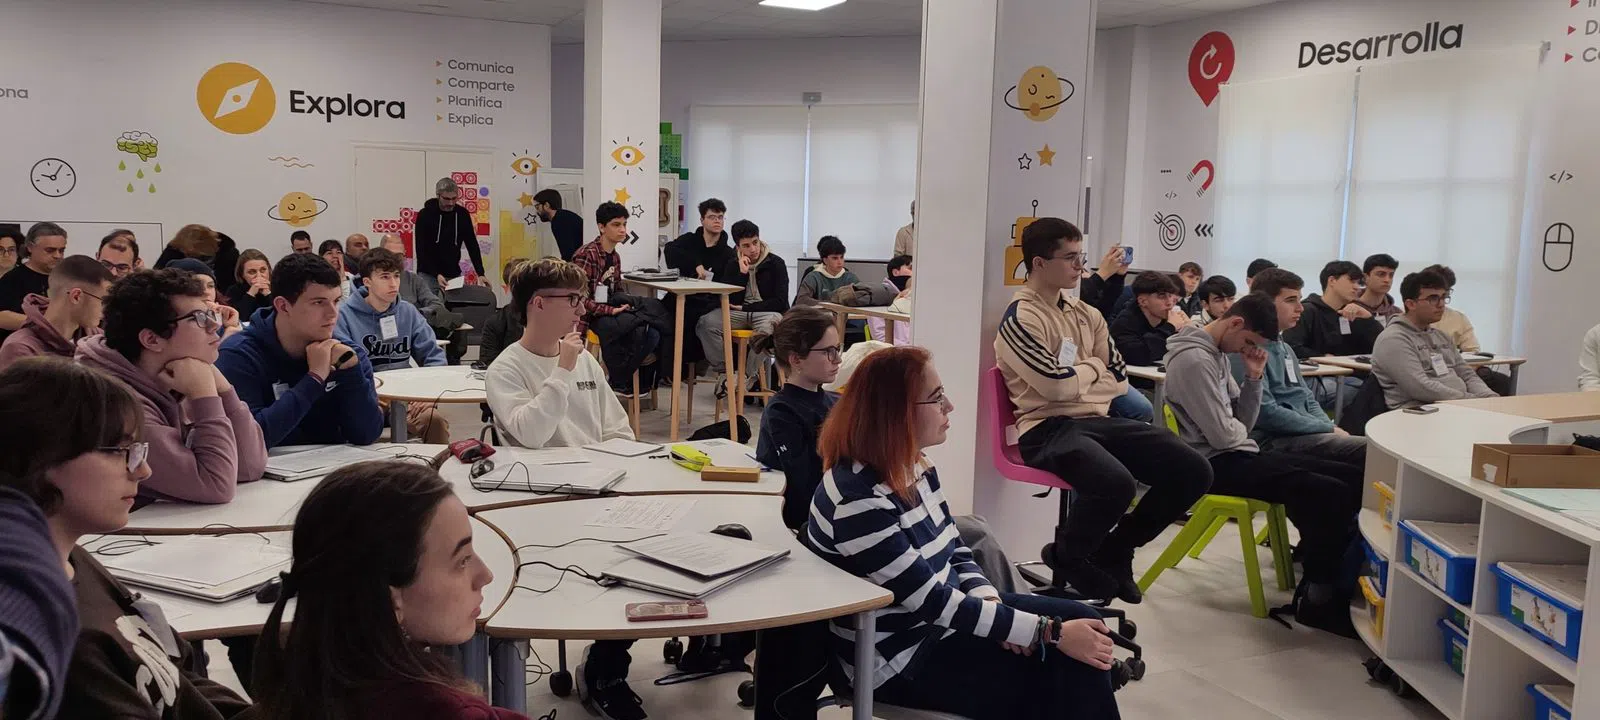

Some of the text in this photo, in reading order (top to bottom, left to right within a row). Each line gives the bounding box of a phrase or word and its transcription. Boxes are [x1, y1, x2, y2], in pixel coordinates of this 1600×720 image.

[1298, 21, 1463, 68] Desarrolla
[448, 59, 514, 74] Comunica
[448, 77, 515, 93] Comparte
[289, 90, 406, 123] Explora
[448, 95, 503, 108] Planifica
[448, 112, 494, 127] Explica
